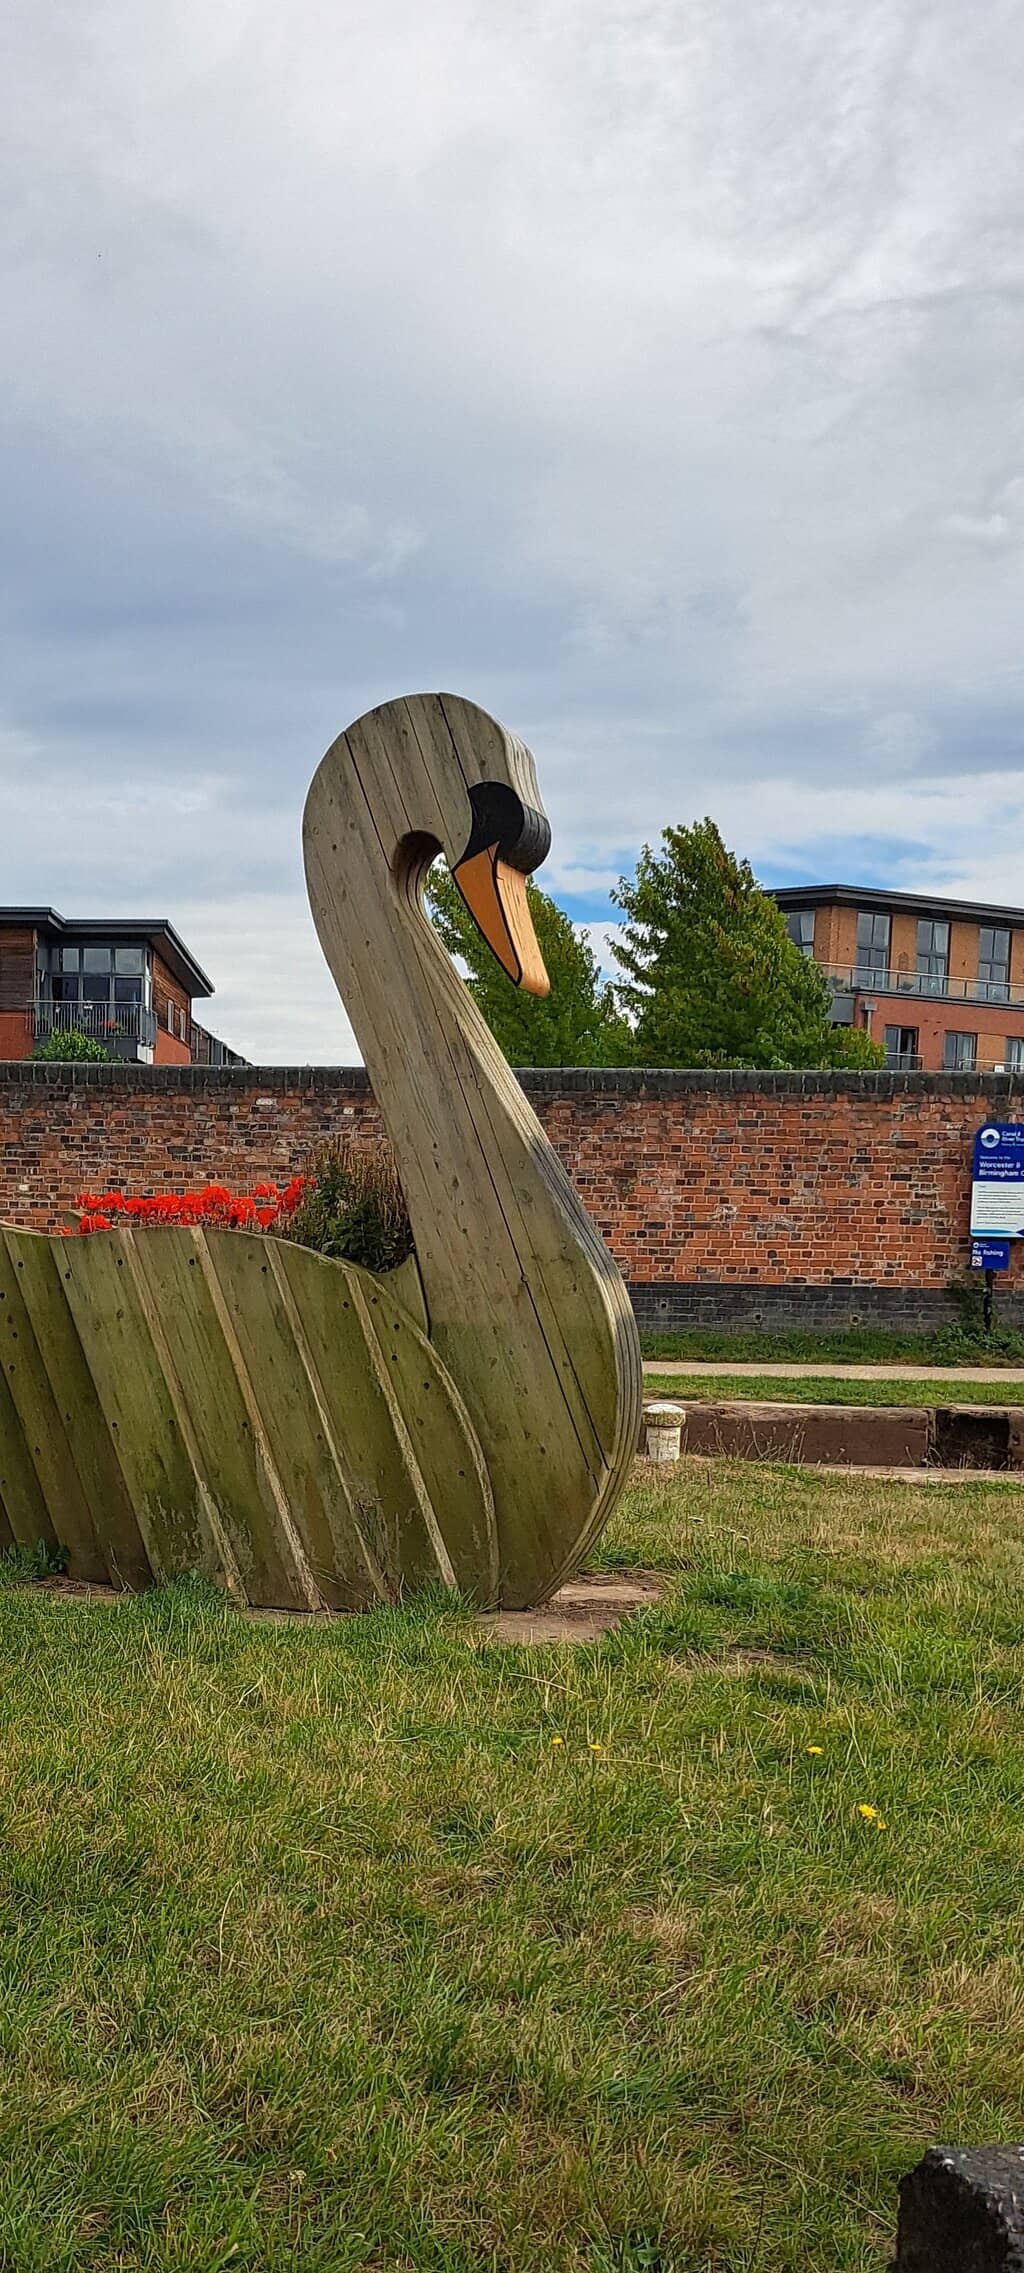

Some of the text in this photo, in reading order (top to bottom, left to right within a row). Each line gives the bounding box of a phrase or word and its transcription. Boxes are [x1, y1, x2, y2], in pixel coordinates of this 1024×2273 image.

[979, 1161, 1015, 1169] Worcester
[979, 1169, 1019, 1177] Birmingham
[983, 1249, 1004, 1257] fishing
